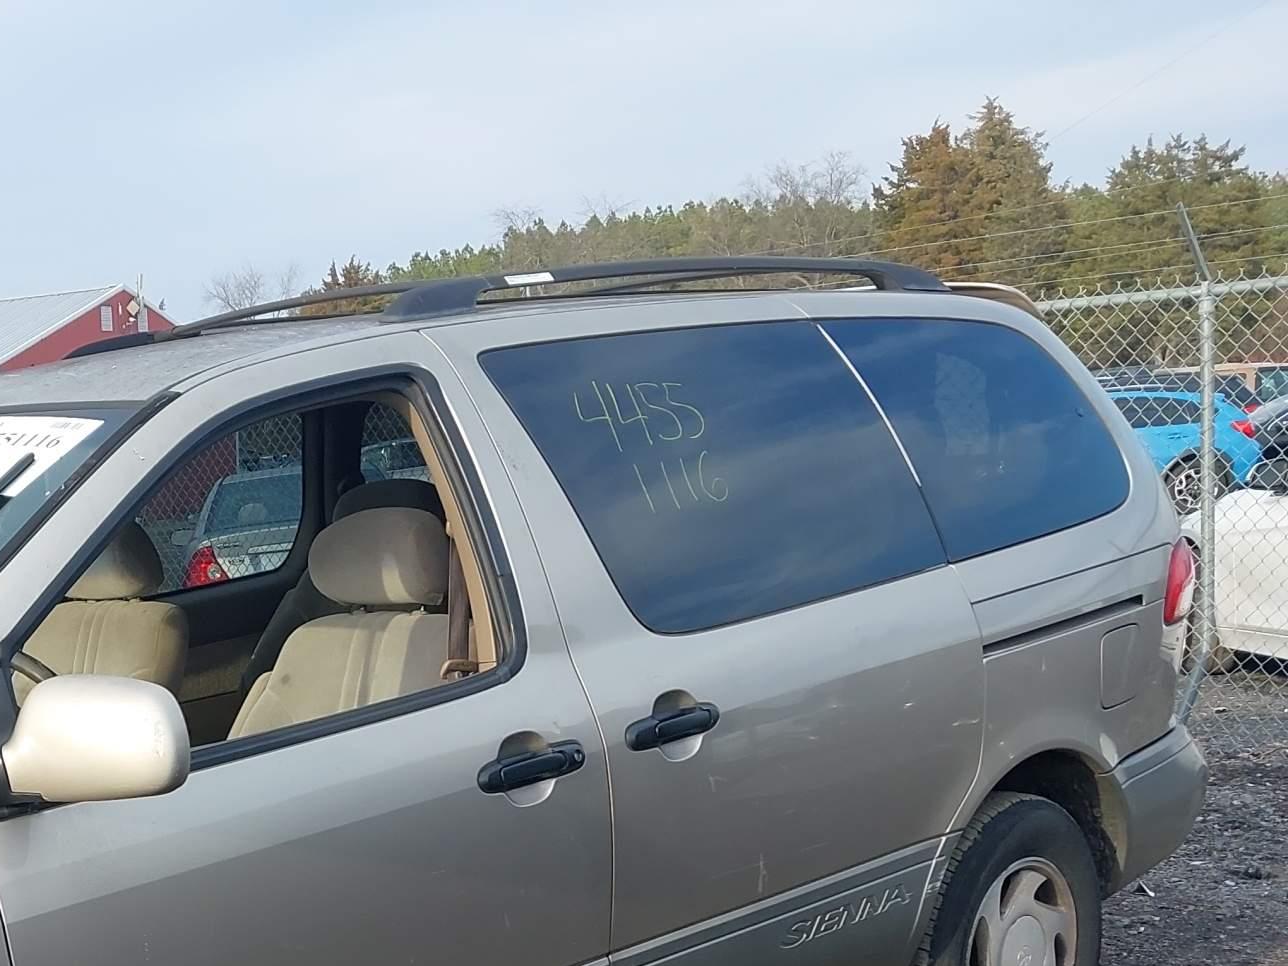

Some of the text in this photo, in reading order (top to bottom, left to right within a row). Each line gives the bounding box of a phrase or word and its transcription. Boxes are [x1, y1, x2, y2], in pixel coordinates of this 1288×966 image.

[573, 380, 705, 452] 4455
[633, 450, 729, 514] 1116
[779, 883, 913, 949] SIENNA
